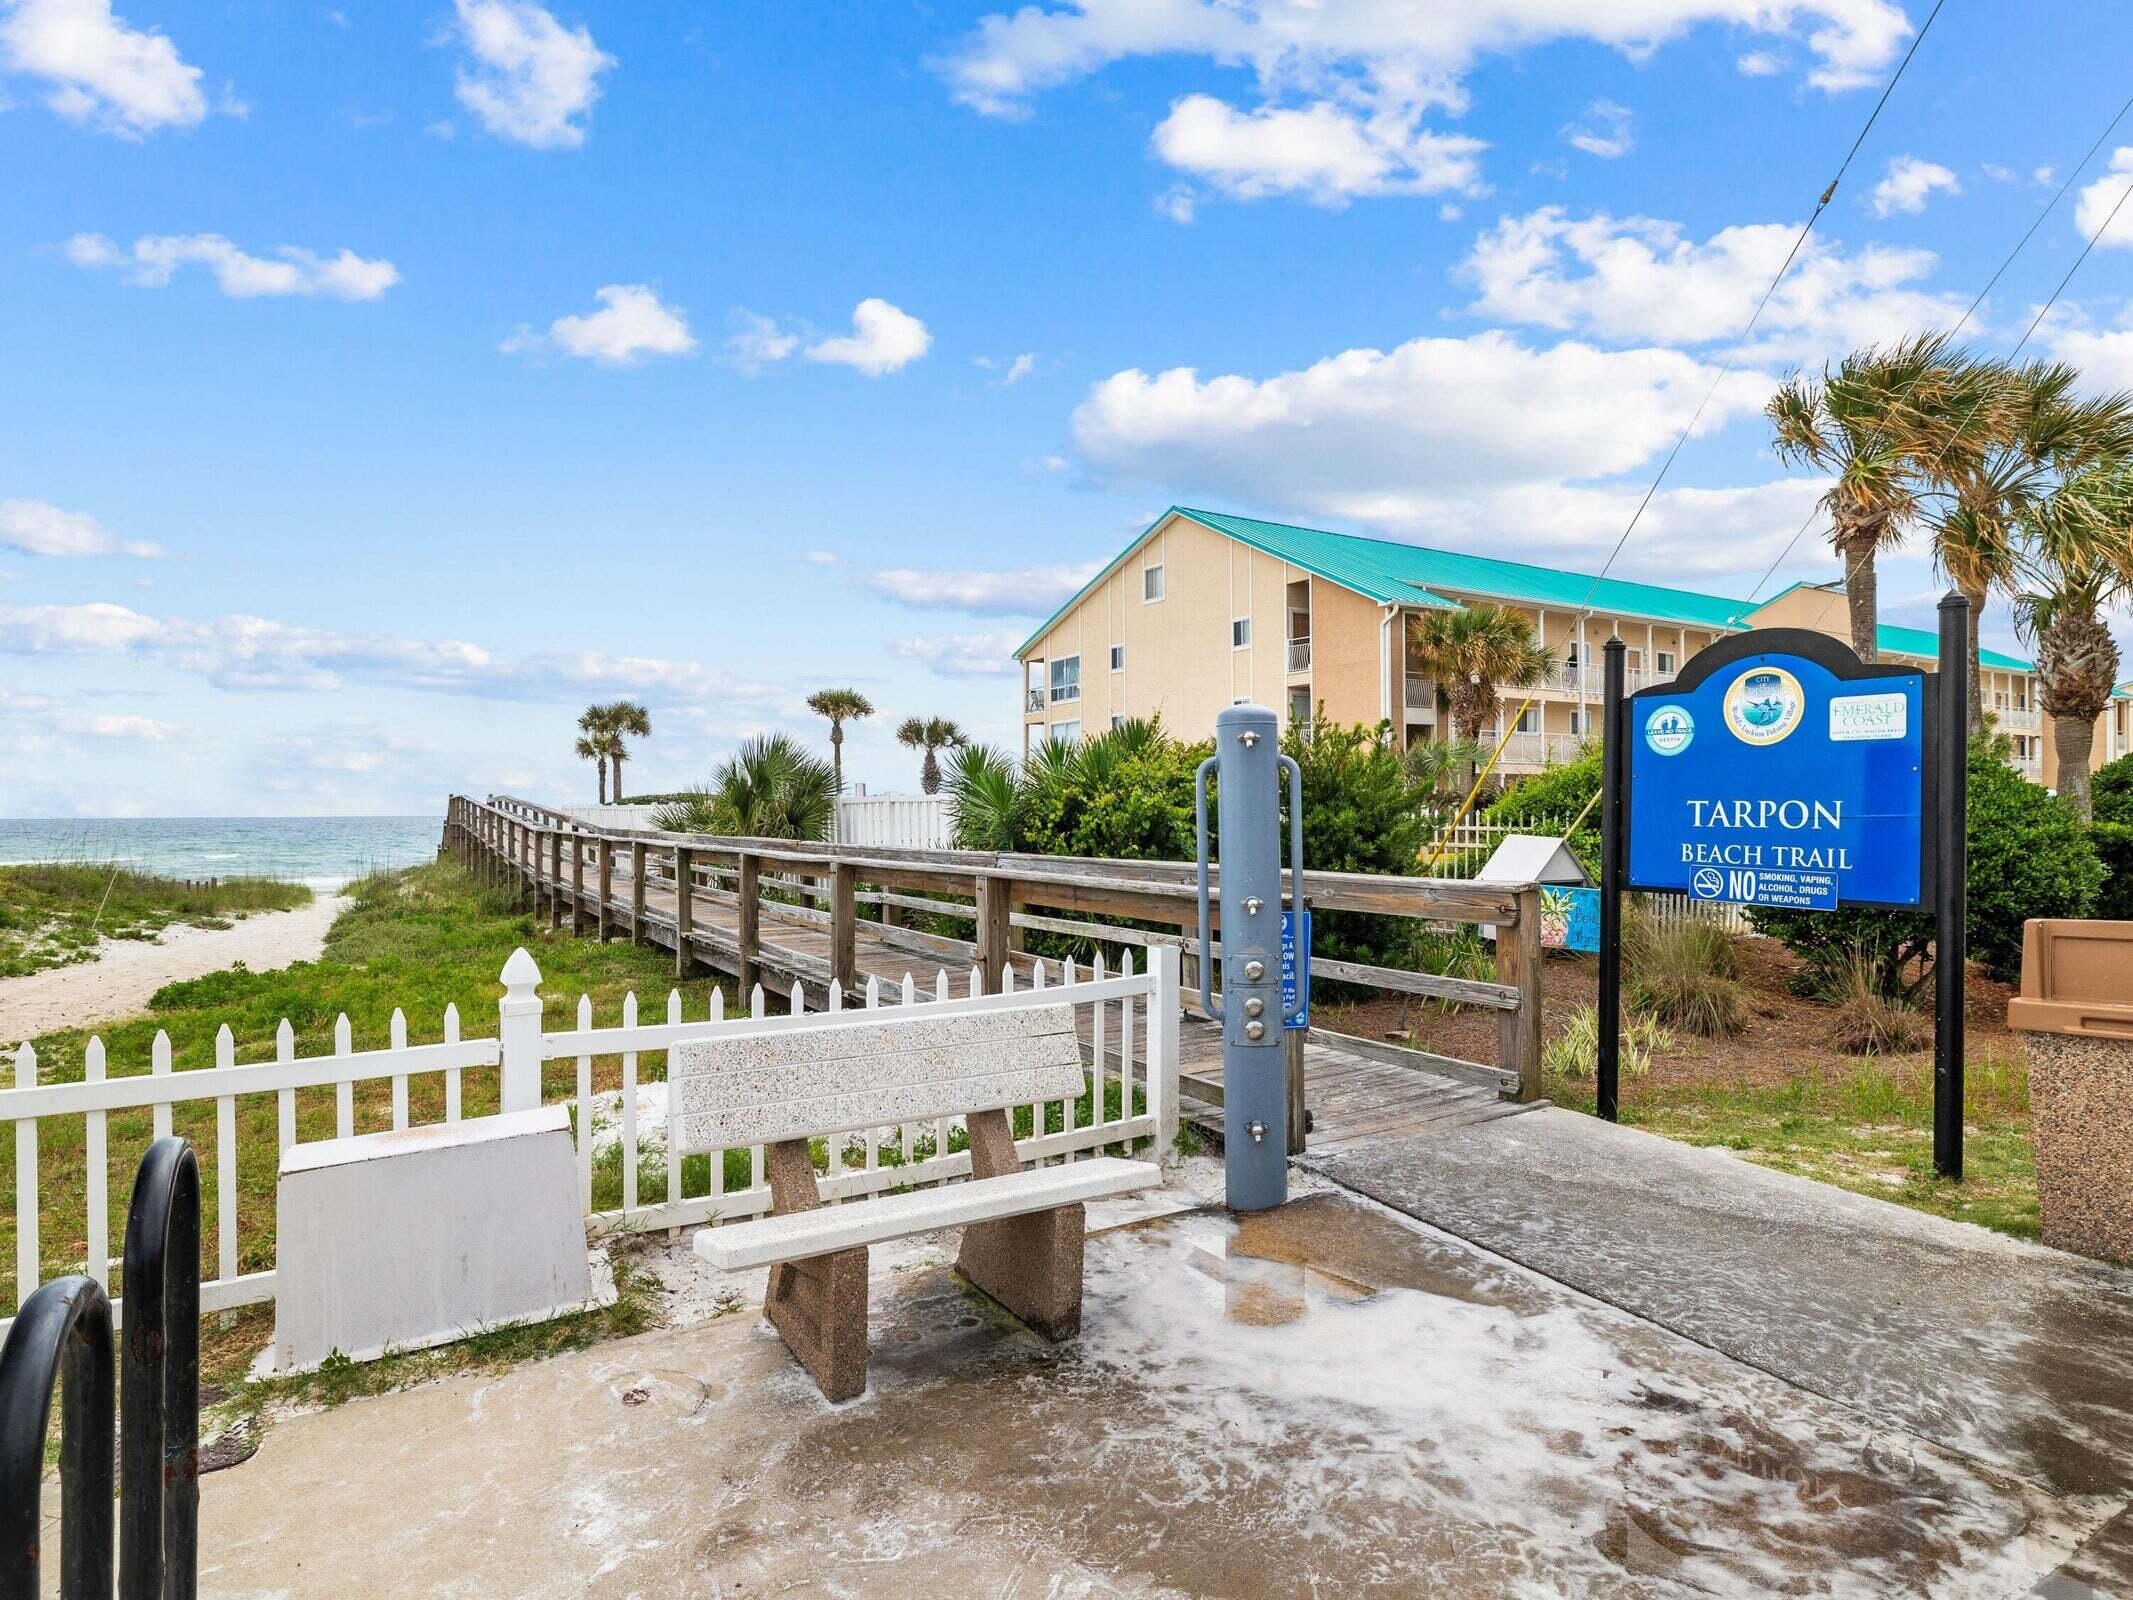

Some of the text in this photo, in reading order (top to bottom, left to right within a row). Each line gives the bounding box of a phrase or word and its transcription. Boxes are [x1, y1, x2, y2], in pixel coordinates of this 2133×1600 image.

[1832, 702, 1905, 717] EMERALD
[1843, 714, 1891, 727] COAST
[1686, 799, 1844, 830] TARPON
[1681, 843, 1853, 870] BEACH TRAIL
[1729, 870, 1756, 901] NO
[1758, 872, 1834, 886] SMOKING, VAPING,
[1758, 884, 1828, 896] ALCOHOL, DRUGS
[1758, 894, 1811, 905] OR WEAPONS
